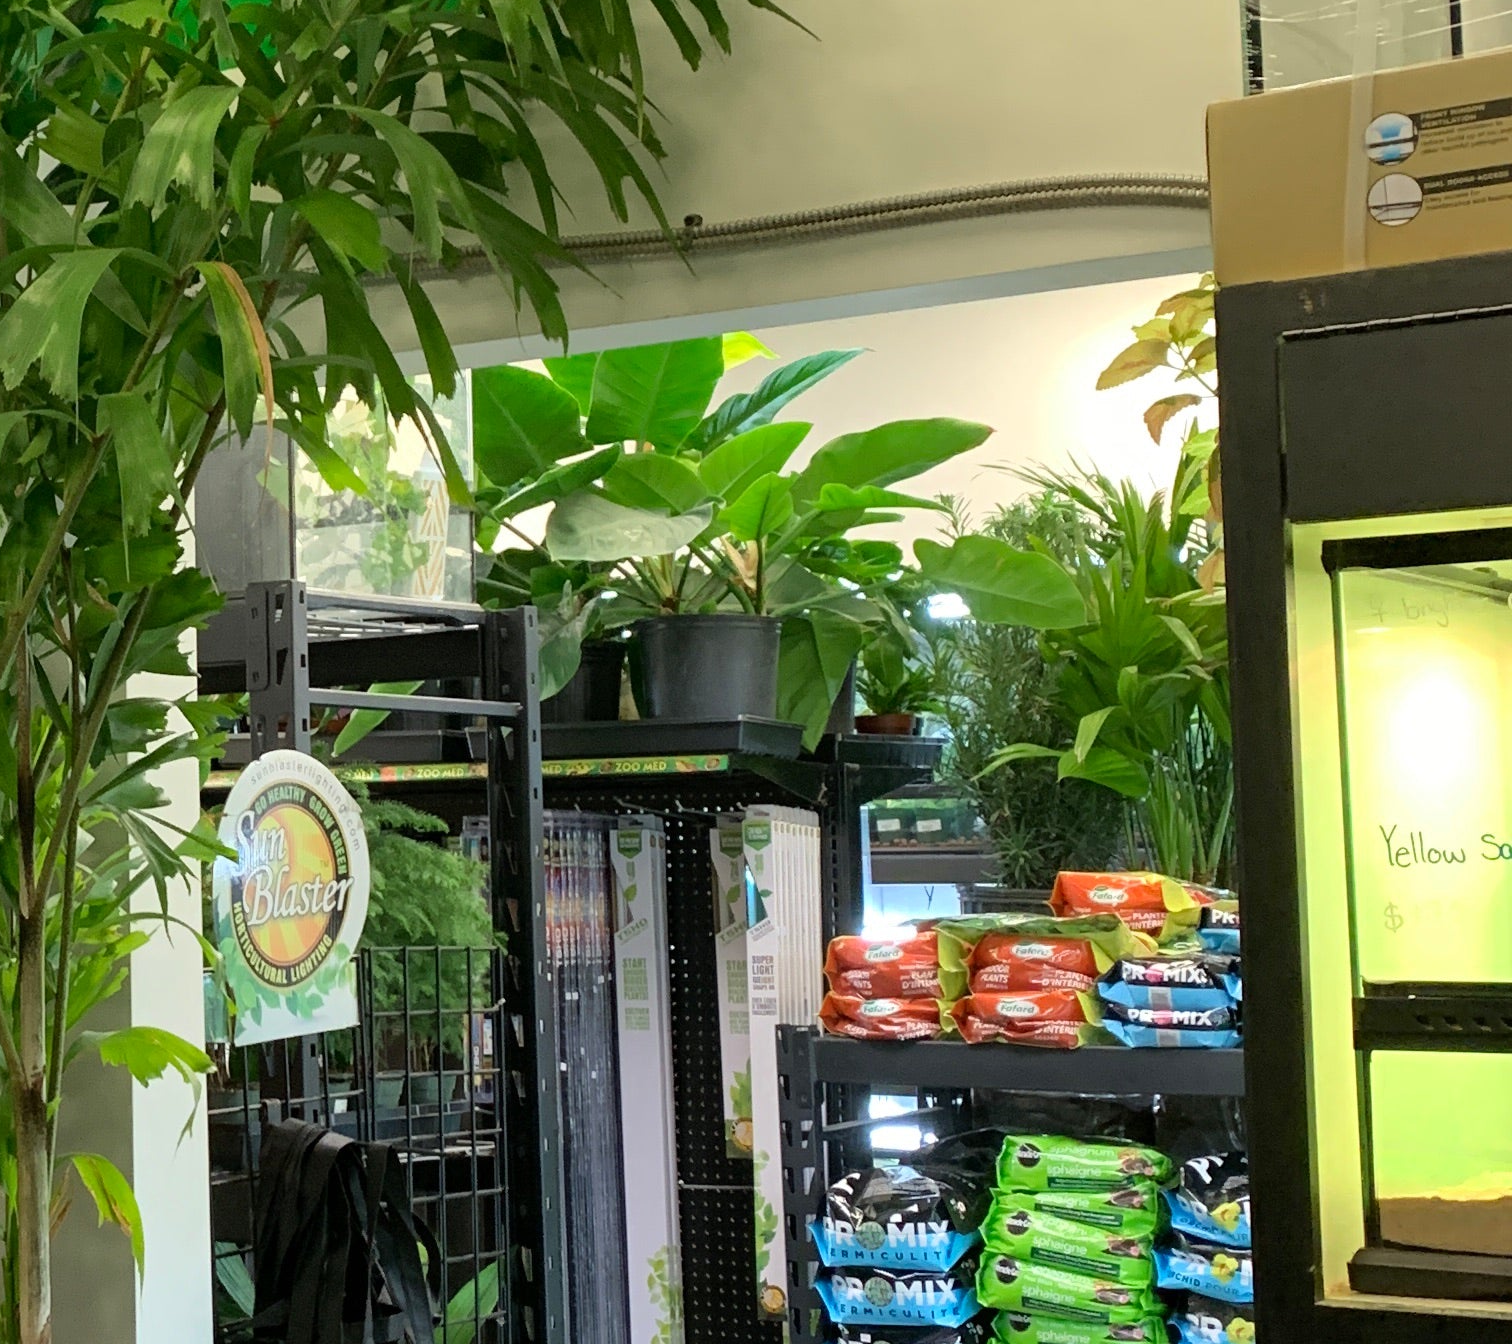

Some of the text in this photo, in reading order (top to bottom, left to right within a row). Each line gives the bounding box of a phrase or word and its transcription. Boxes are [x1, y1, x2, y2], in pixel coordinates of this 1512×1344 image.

[417, 766, 464, 779] ZOO MED
[615, 760, 666, 773] ZOO MED
[255, 785, 306, 815] GO HEALTHY
[309, 795, 347, 875] GROW GREEN
[231, 810, 286, 877] Sun
[1379, 824, 1466, 868] Yellow
[242, 864, 355, 927] Blaster
[1092, 891, 1125, 901] Fafard
[233, 900, 333, 984] HORTICULTURAL LIGHTING
[868, 950, 899, 960] Fafard
[752, 965, 774, 975] LIGHT
[1000, 1004, 1035, 1014] Fafard
[1047, 1164, 1102, 1177] sphaigne
[1033, 1237, 1088, 1255] sphaigne
[830, 1248, 952, 1261] ERMICULITE
[1022, 1286, 1076, 1303] sphaigne
[840, 1305, 961, 1320] ERMICULITE
[1037, 1330, 1091, 1344] sphaigne
